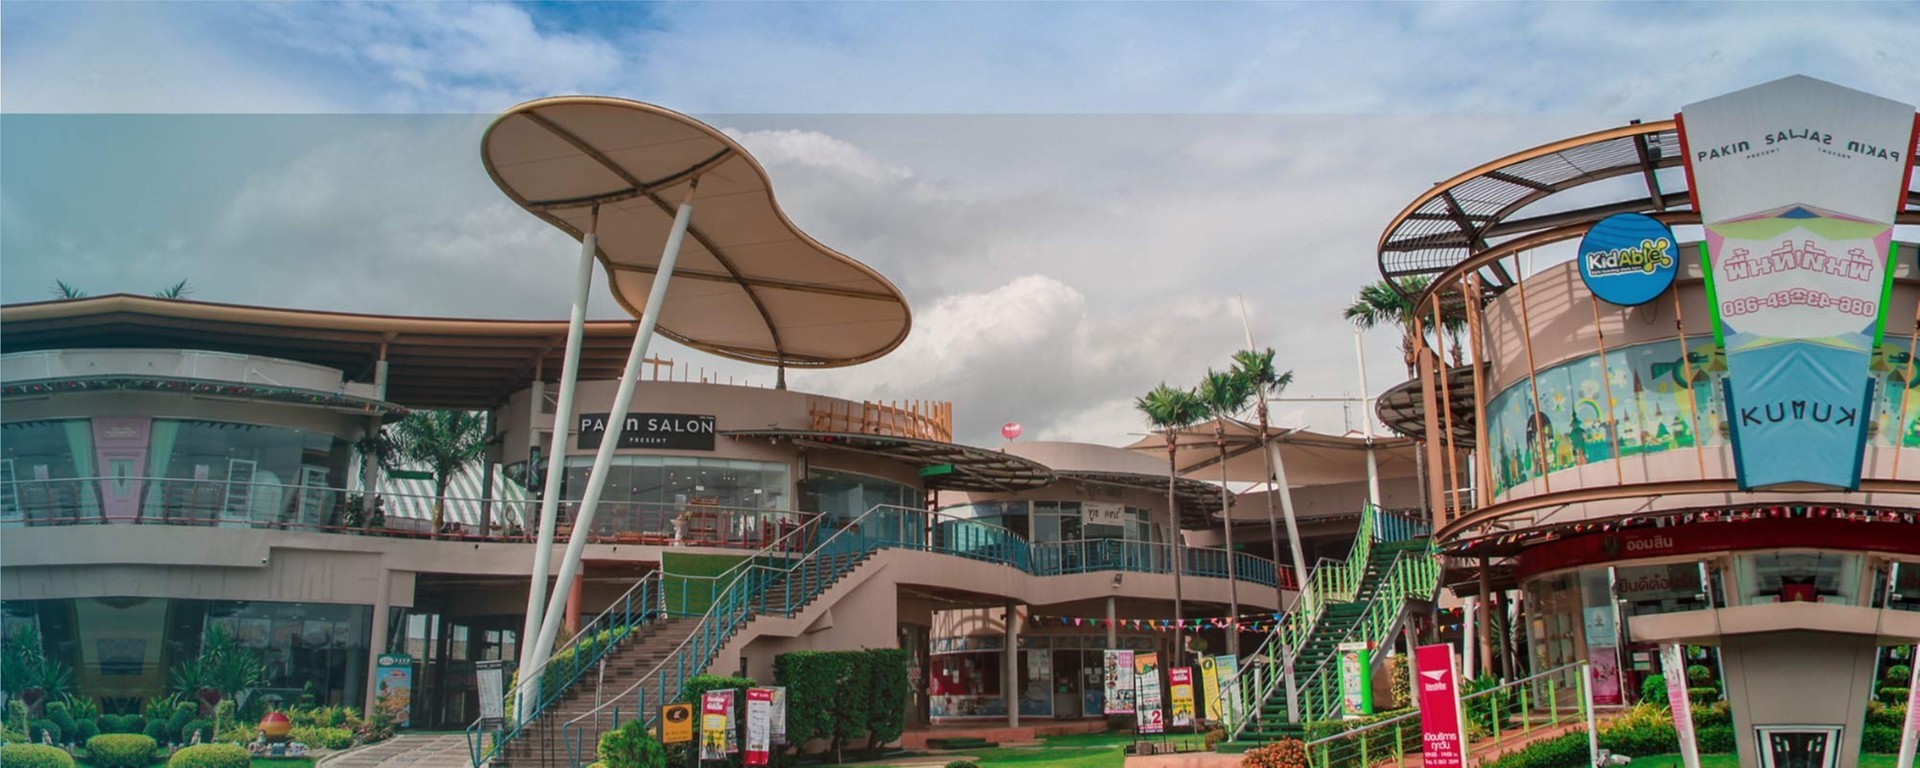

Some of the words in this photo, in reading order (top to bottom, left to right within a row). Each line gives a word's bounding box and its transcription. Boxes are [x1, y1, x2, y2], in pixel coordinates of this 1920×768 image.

[1588, 246, 1662, 270] KidAble
[648, 418, 714, 433] SALON
[1626, 535, 1674, 551] ออมสิน
